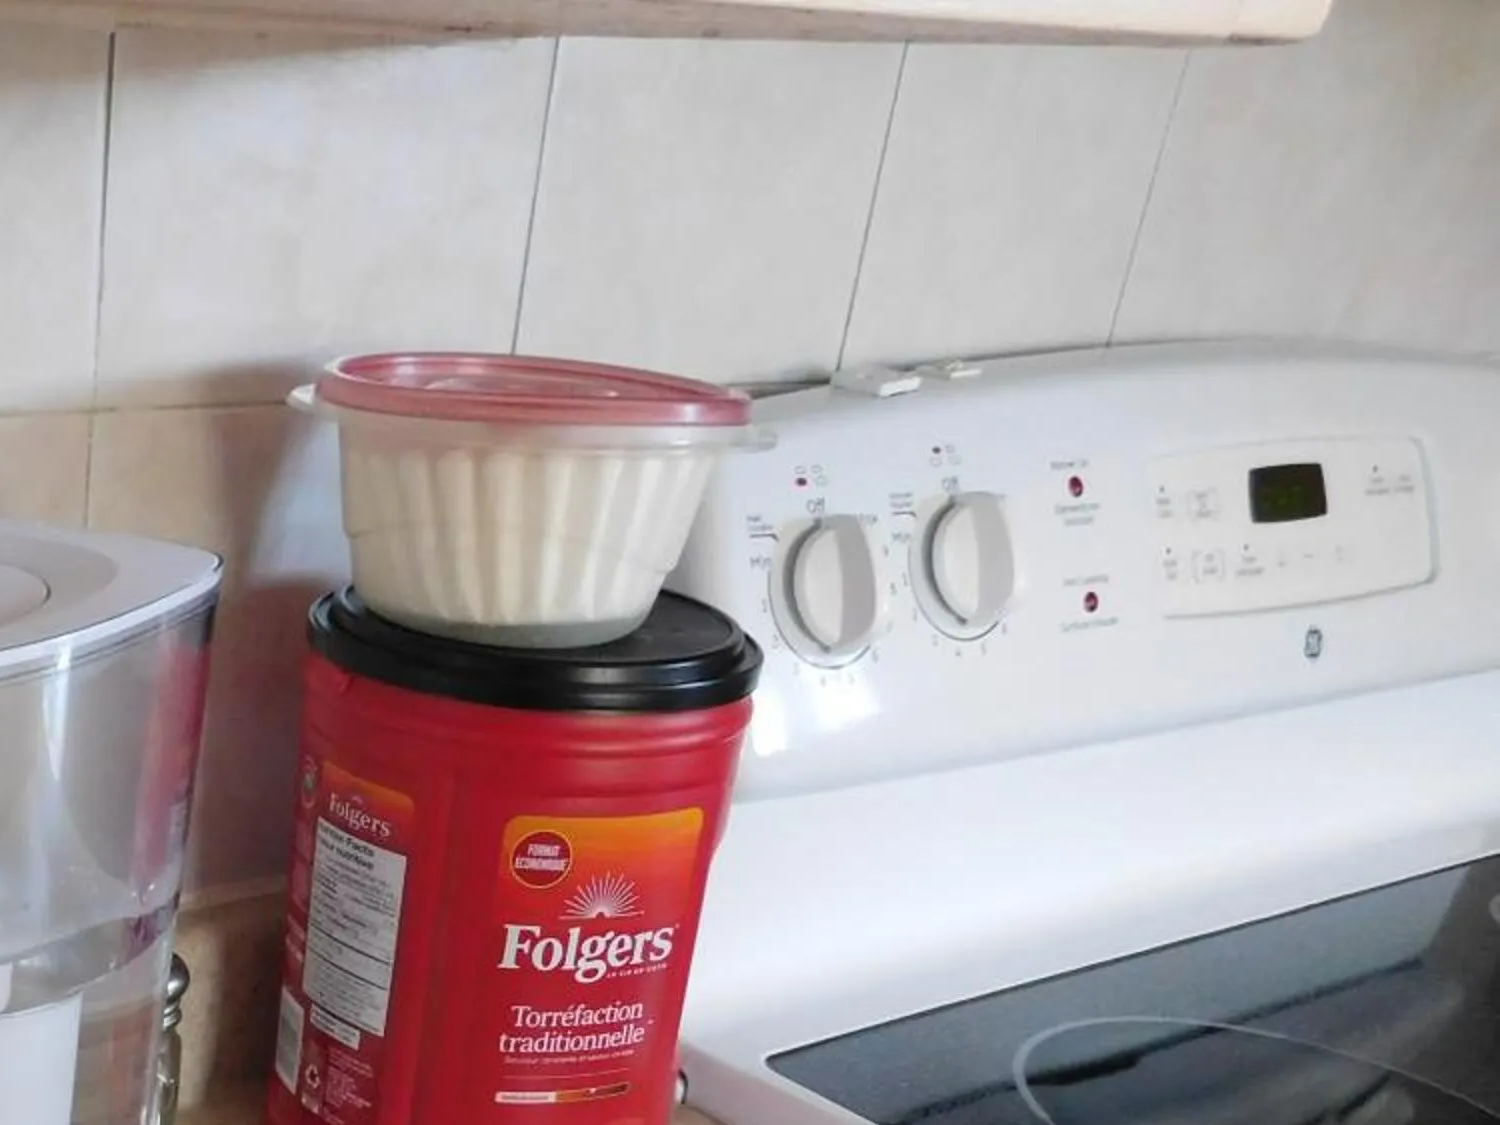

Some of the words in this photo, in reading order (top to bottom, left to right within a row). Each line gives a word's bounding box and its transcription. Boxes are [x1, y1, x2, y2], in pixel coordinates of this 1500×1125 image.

[497, 922, 675, 984] Folgers
[511, 1000, 643, 1028] Torréfaction
[499, 1023, 645, 1053] traditionnelle
